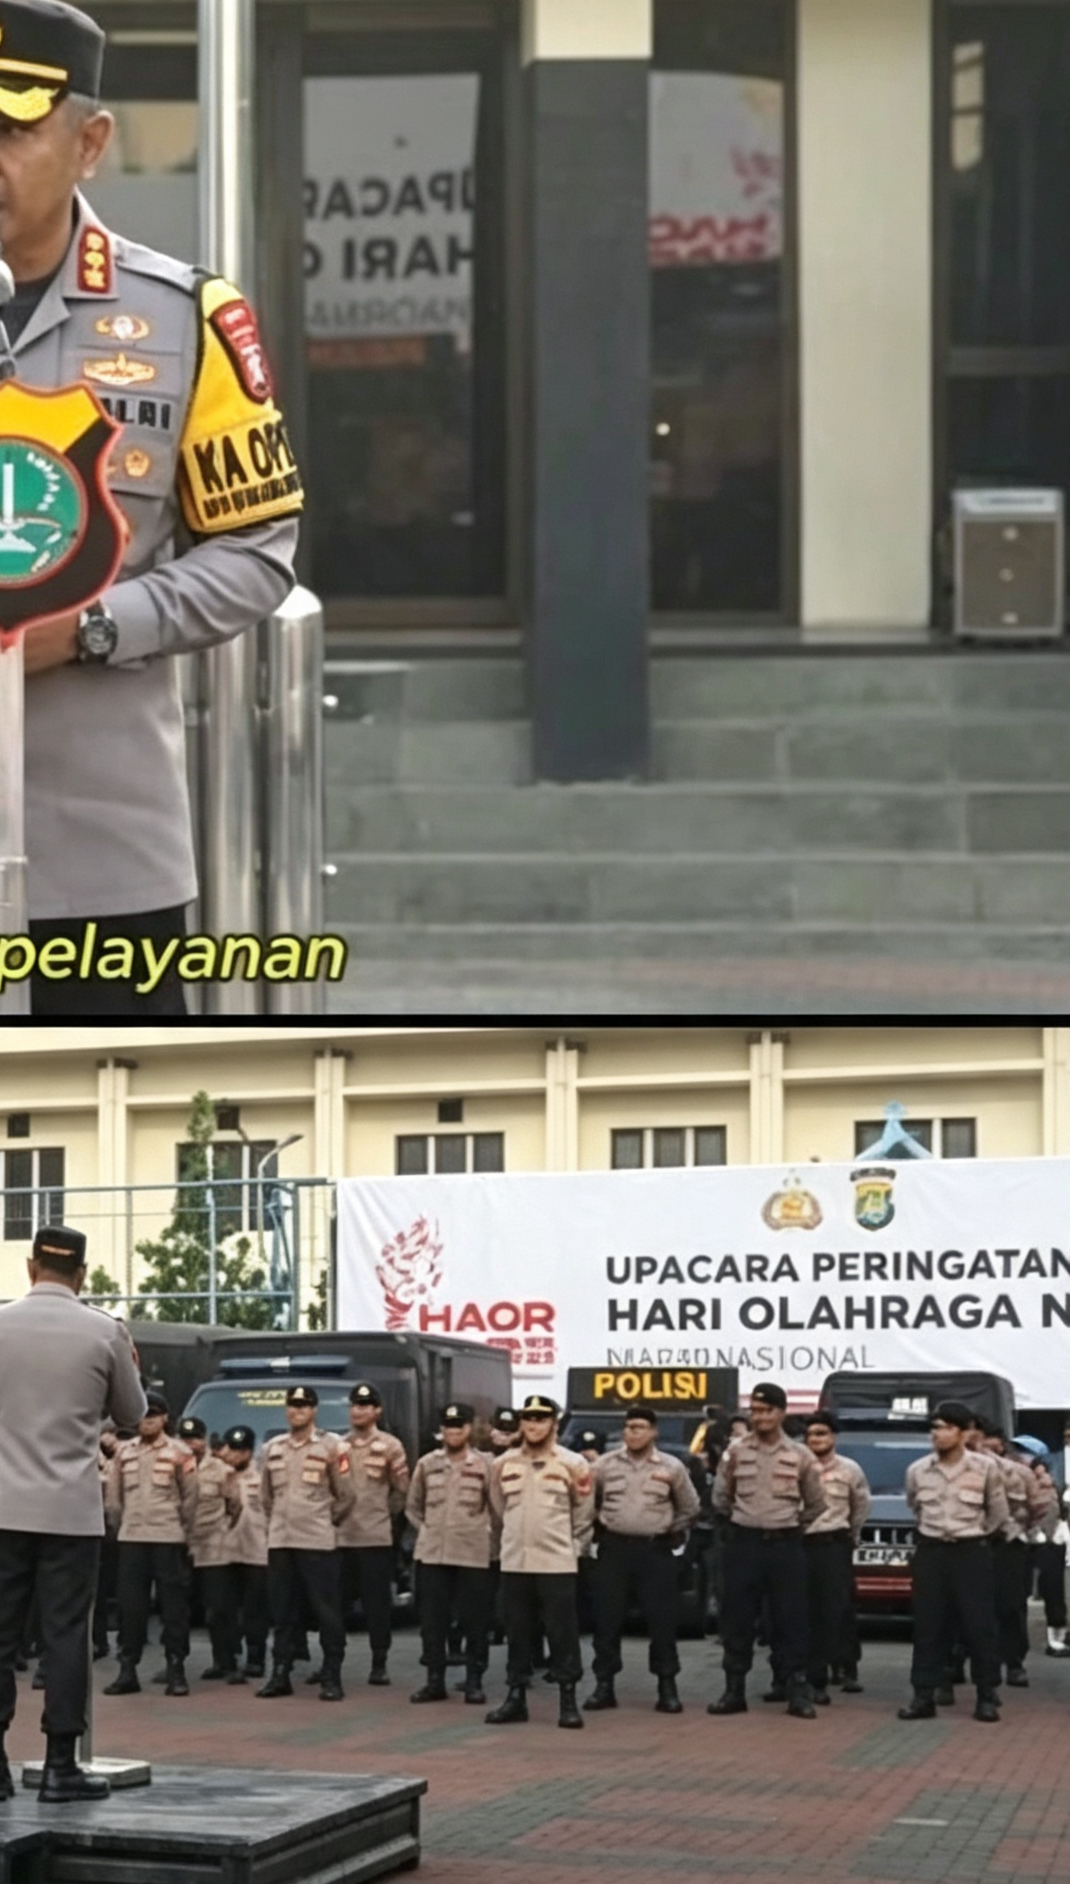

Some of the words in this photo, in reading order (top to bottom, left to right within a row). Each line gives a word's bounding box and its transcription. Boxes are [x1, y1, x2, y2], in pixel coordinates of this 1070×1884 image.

[193, 435, 248, 494] KA
[606, 1252, 800, 1284] UPACARA
[812, 1247, 1070, 1282] PERINGATAN
[419, 1301, 555, 1332] HAOR
[607, 1298, 722, 1332] HARI
[738, 1293, 1023, 1331] OLAHRAGA
[594, 1372, 708, 1399] POLISI
